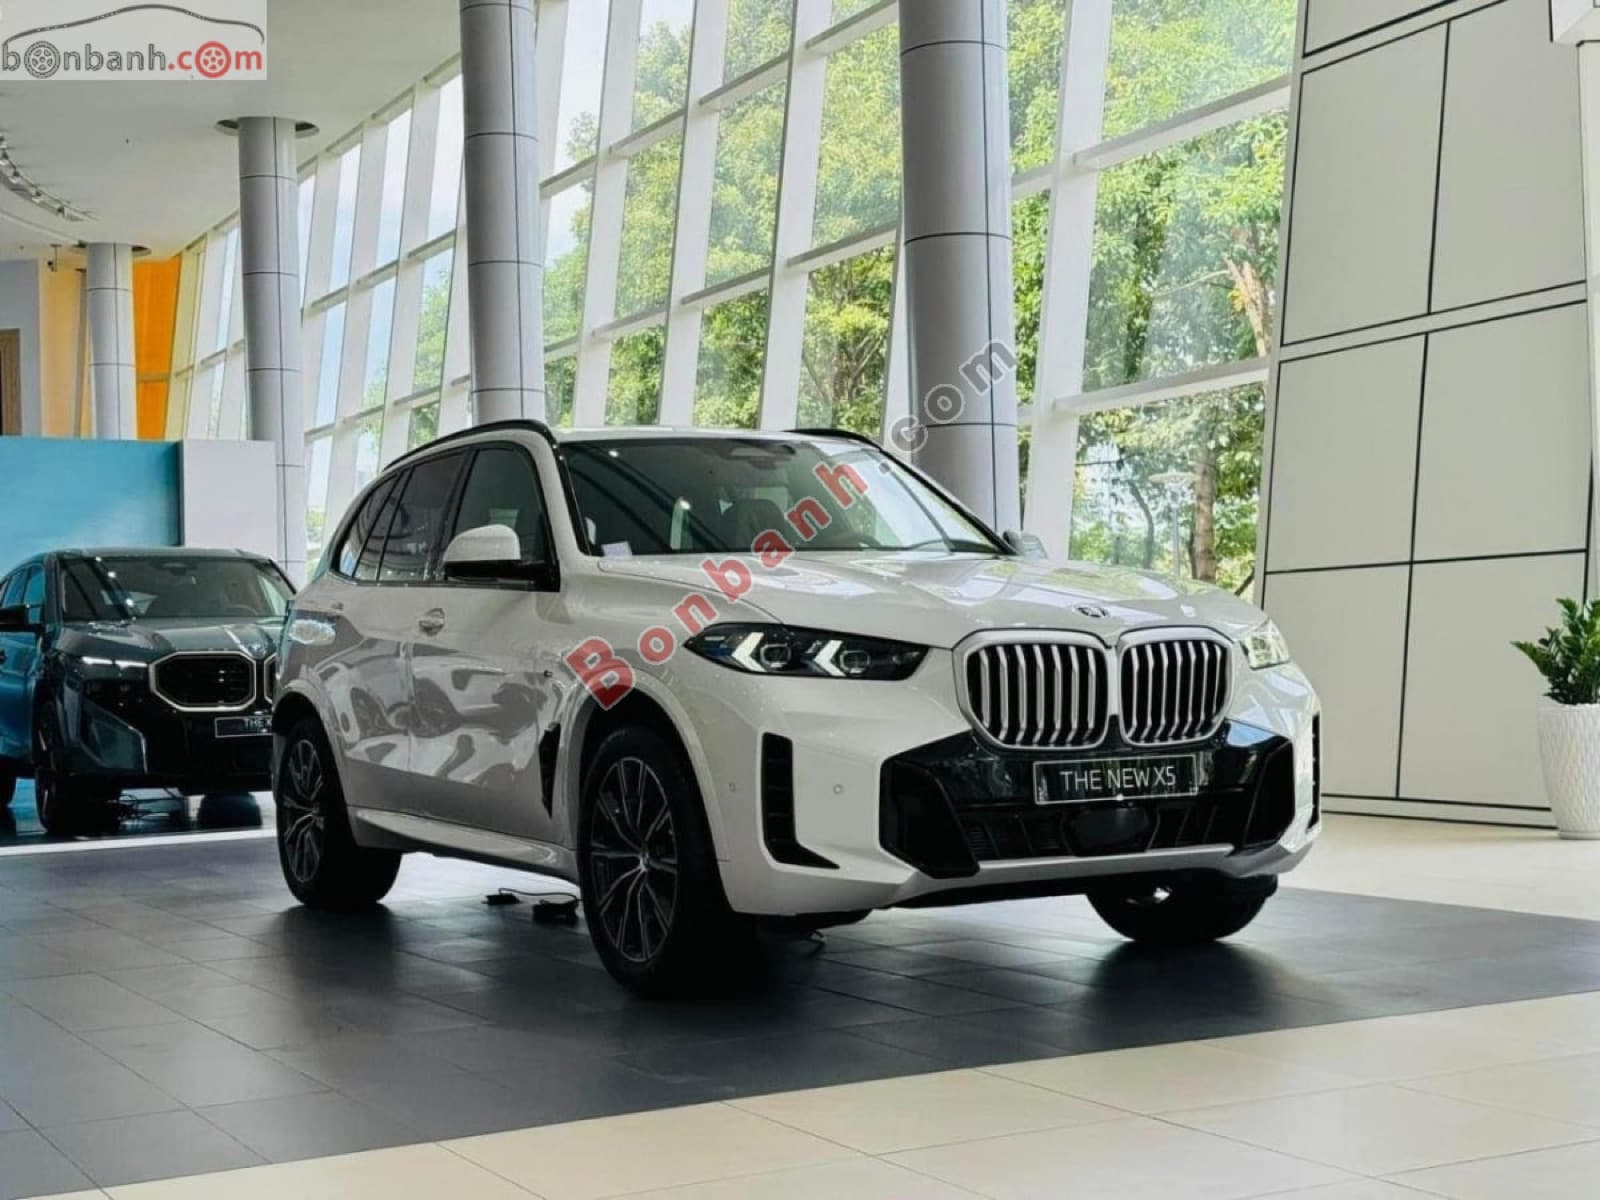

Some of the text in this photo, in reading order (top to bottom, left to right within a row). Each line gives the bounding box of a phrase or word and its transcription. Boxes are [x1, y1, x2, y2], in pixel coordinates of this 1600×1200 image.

[1060, 766, 1176, 792] THE NEW X5
